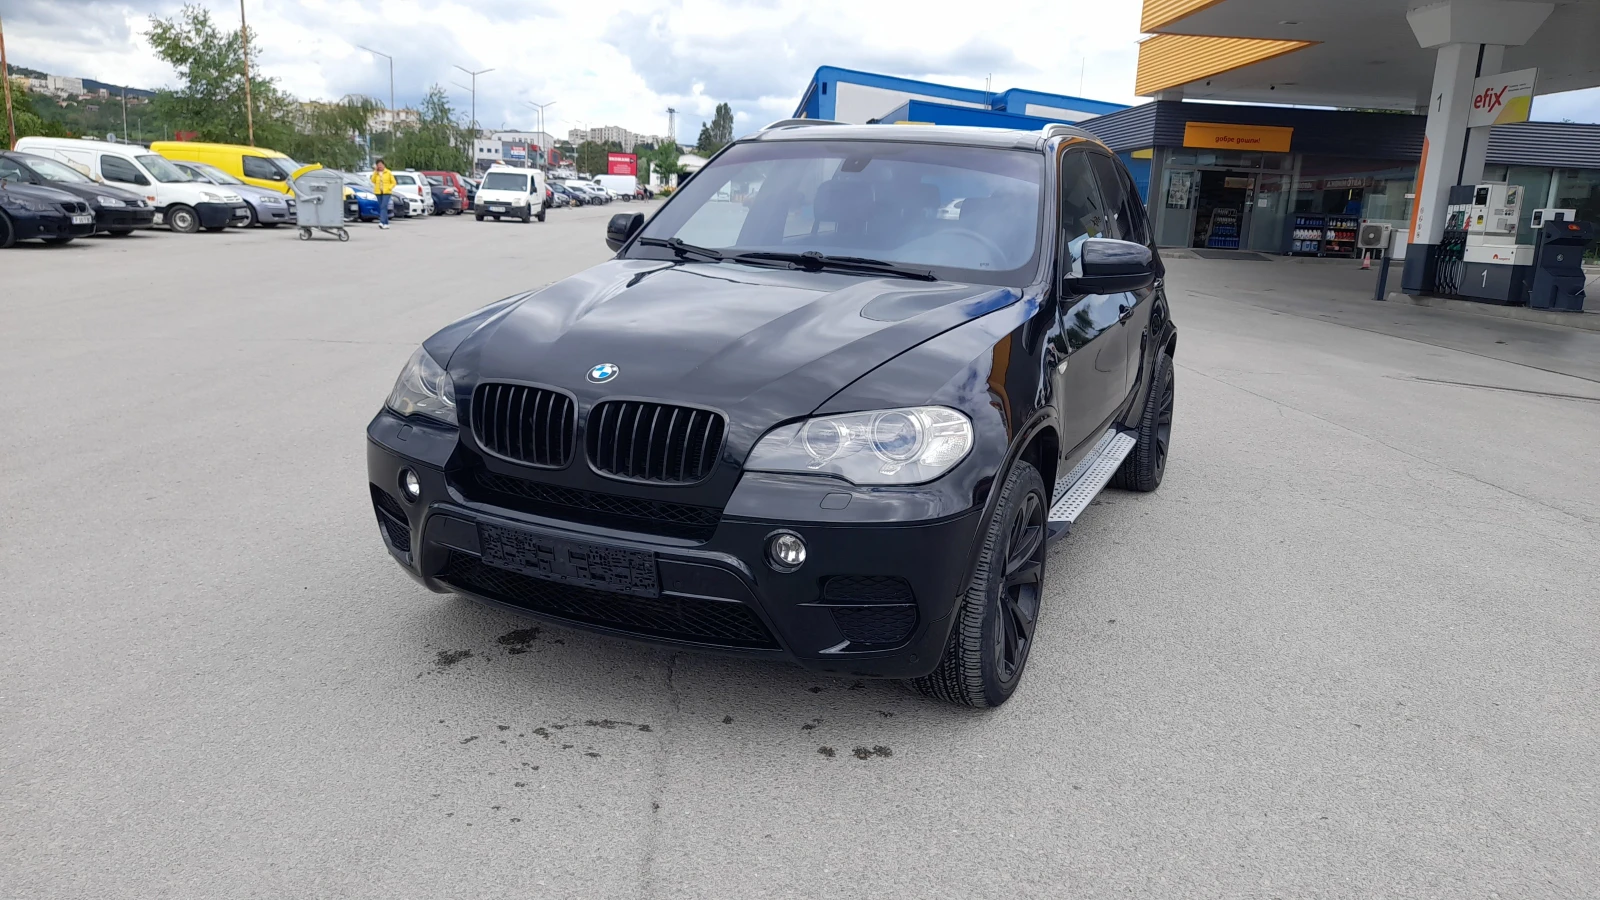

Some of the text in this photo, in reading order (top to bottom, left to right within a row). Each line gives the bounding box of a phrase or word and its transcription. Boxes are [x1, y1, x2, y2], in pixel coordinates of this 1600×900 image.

[1436, 92, 1443, 113] 1
[1474, 85, 1508, 113] efix
[1215, 135, 1261, 145] добре дошли!
[1481, 269, 1488, 288] 1
